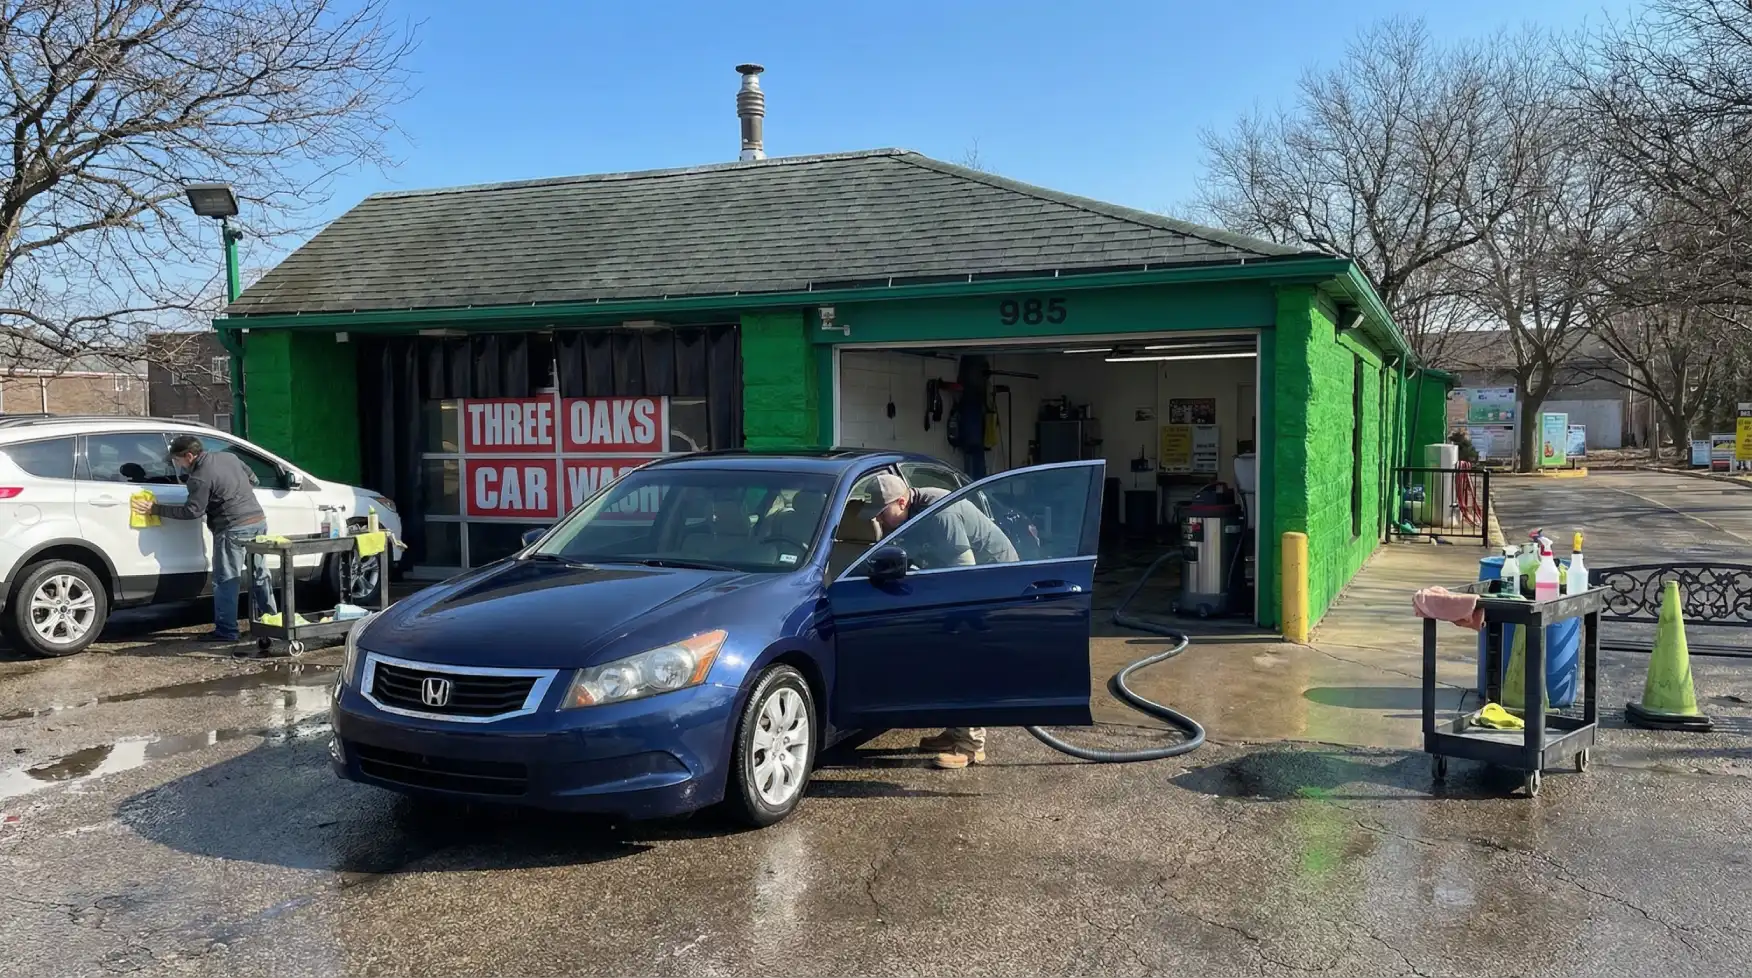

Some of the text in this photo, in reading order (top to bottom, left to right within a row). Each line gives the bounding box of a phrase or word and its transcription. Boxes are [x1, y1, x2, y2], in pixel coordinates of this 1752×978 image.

[999, 297, 1067, 326] 985
[468, 398, 656, 446] THREE OAKS
[475, 466, 549, 511] CAR
